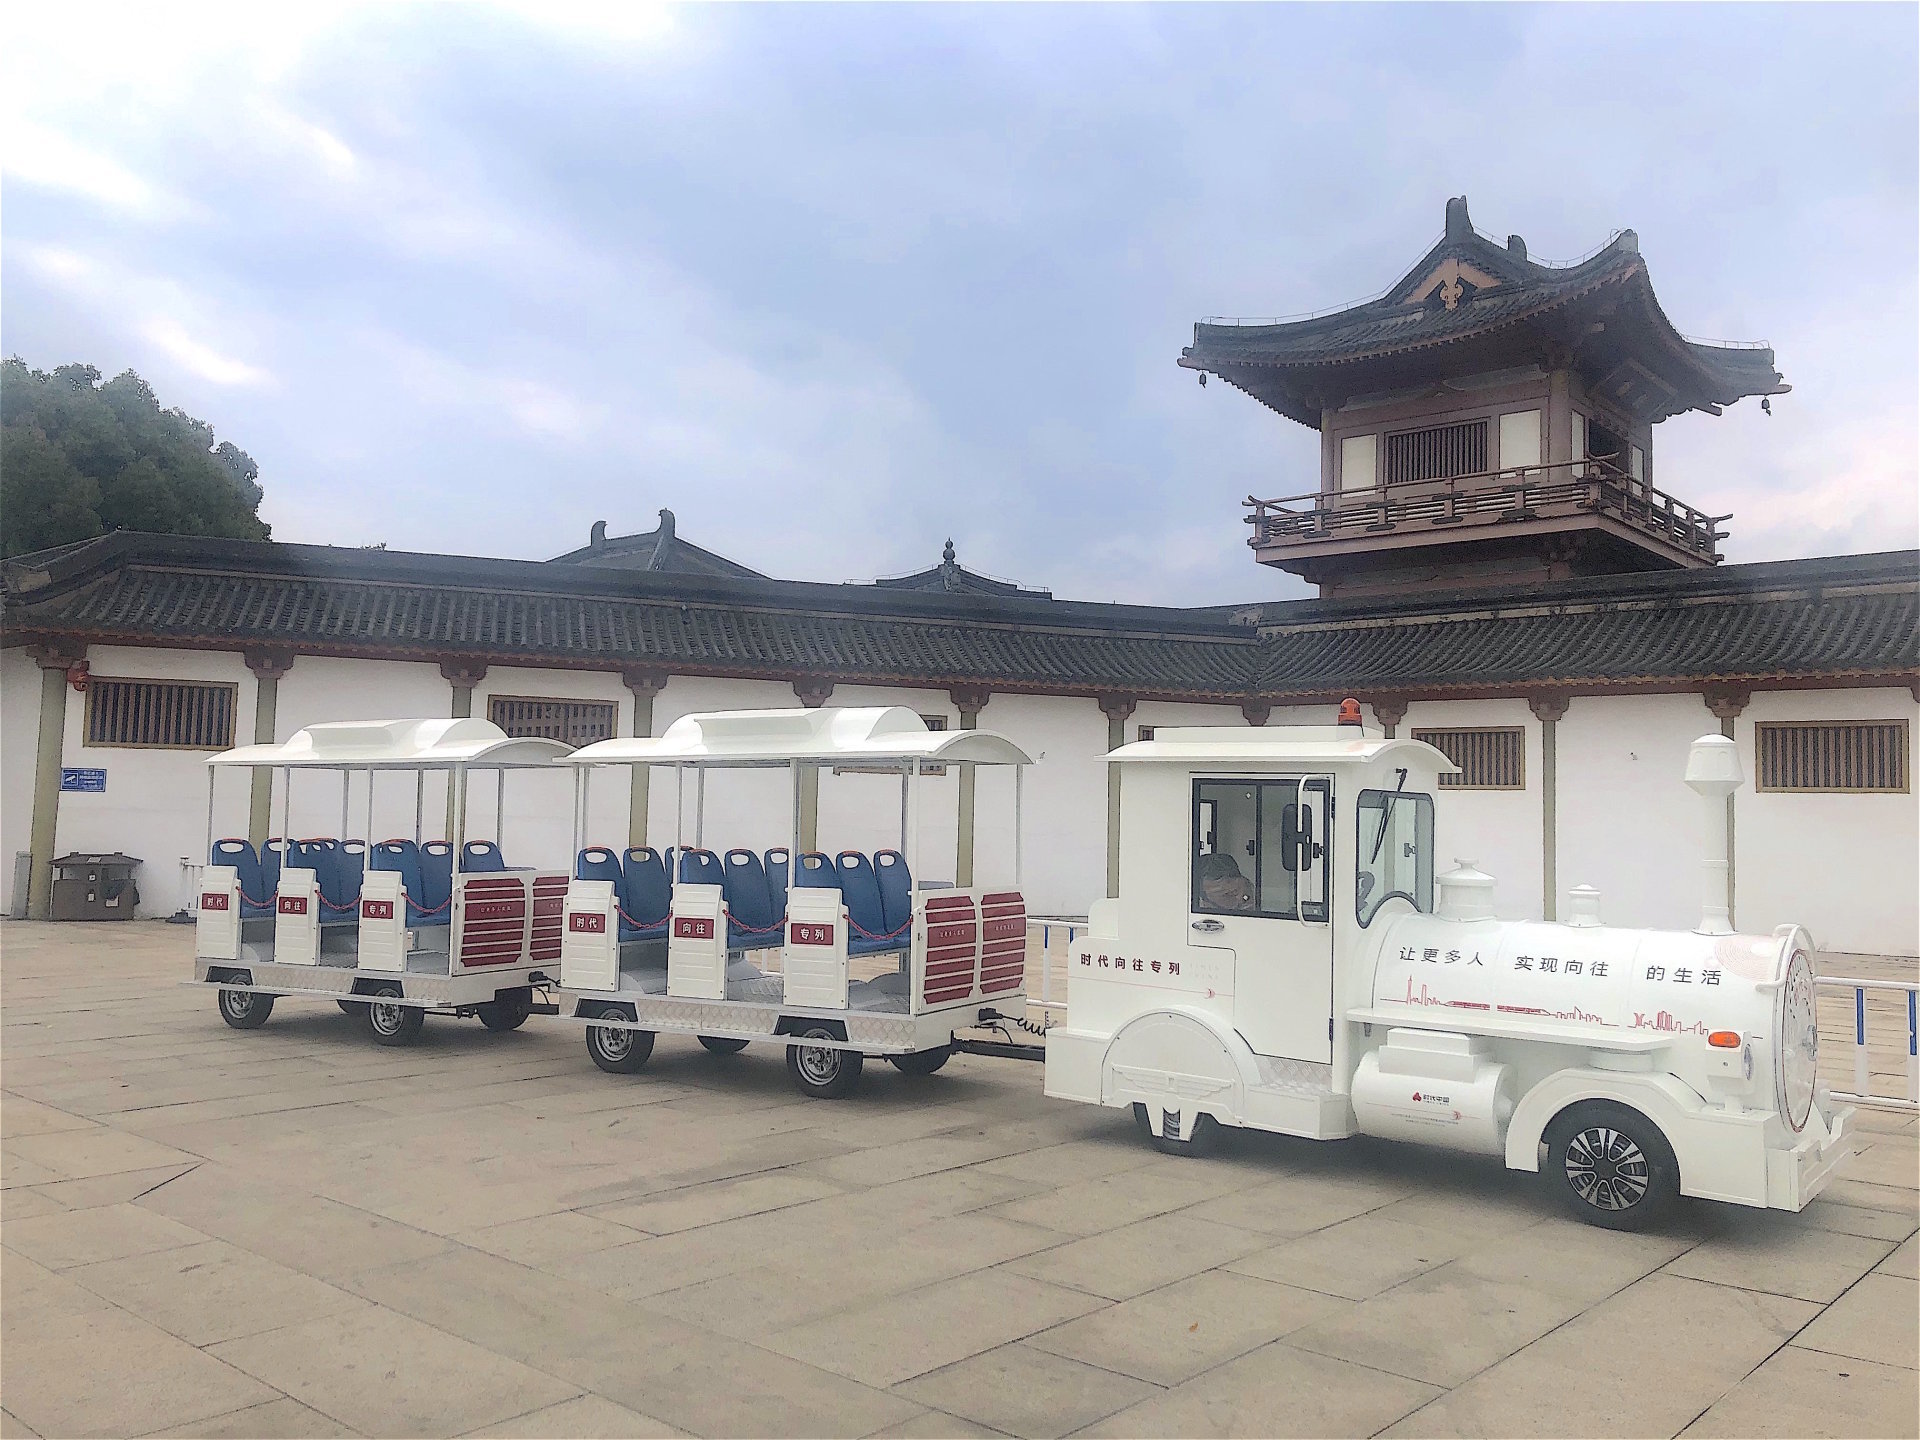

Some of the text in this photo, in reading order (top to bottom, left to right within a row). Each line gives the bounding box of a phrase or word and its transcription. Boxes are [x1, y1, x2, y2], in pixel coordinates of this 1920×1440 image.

[207, 897, 223, 907] 时代
[284, 901, 301, 911] 向往
[368, 905, 387, 915] 专列
[576, 917, 599, 928] 时代
[682, 923, 706, 934] 向往
[800, 928, 825, 941] 专列
[1080, 953, 1180, 976] 时代向往专列
[1399, 946, 1722, 986] 让更多人 实现向往 的生活
